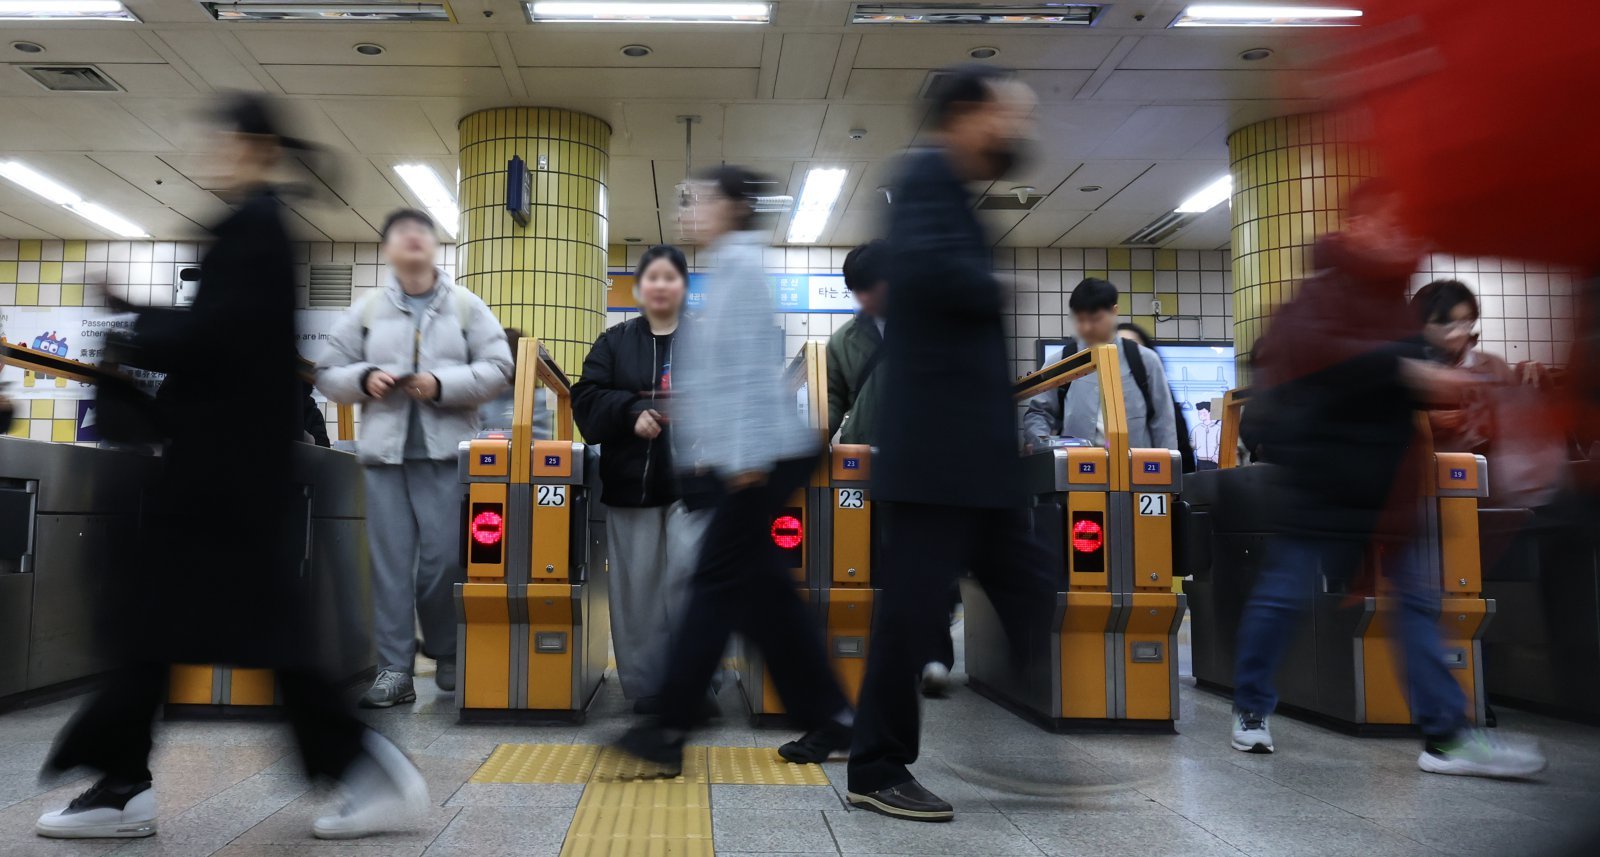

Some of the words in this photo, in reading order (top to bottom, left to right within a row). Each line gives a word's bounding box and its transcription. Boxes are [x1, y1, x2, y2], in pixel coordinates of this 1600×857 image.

[818, 286, 838, 299] 타는
[81, 319, 129, 328] Passengers
[538, 486, 565, 506] 25
[840, 489, 864, 508] 23
[1140, 495, 1166, 515] 21
